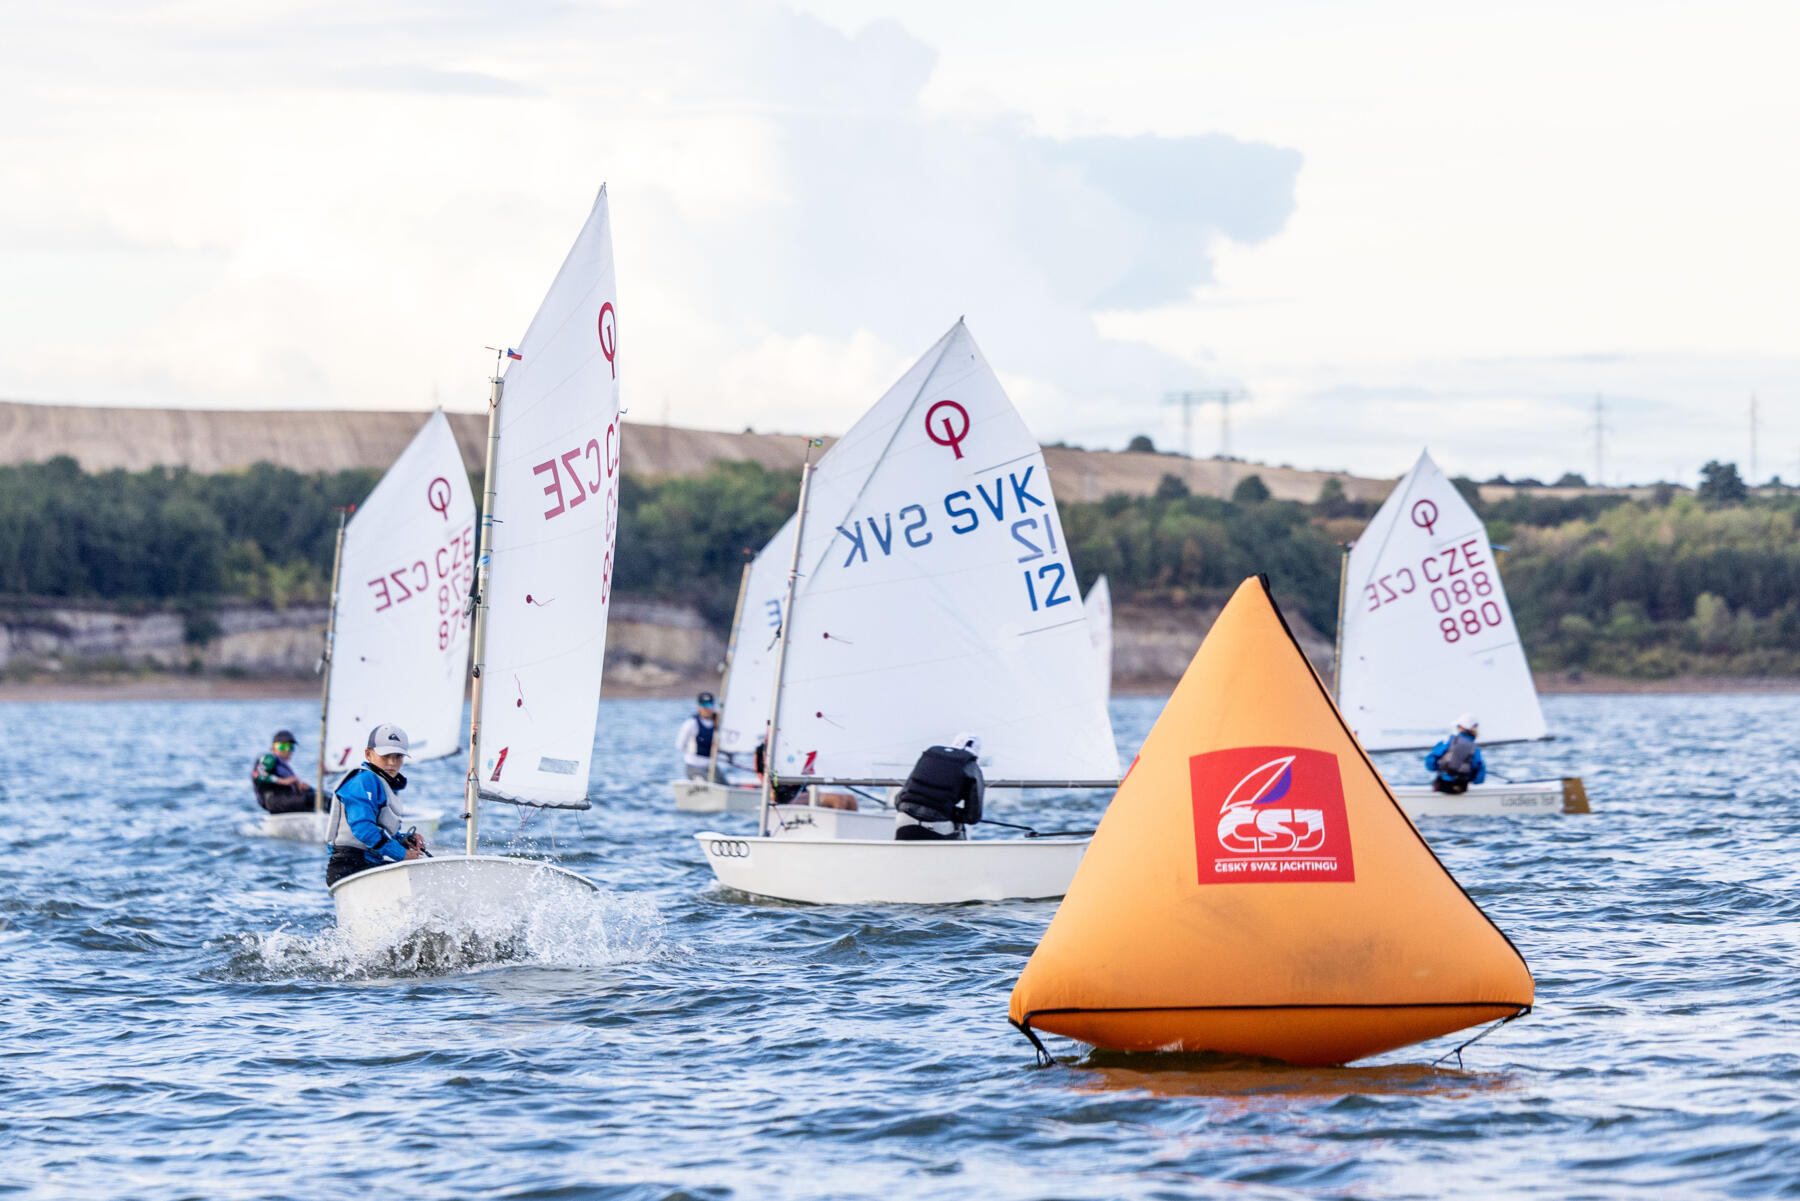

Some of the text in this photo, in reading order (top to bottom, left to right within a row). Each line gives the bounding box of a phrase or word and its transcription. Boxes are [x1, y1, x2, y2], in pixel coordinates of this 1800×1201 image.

[943, 465, 1046, 535] SVK
[435, 526, 473, 579] CZE
[1421, 539, 1486, 584] CZE
[1023, 562, 1071, 612] 12
[1439, 601, 1502, 643] 880
[1214, 860, 1338, 873] ČESKÝ SVAZ JACHTINGU
